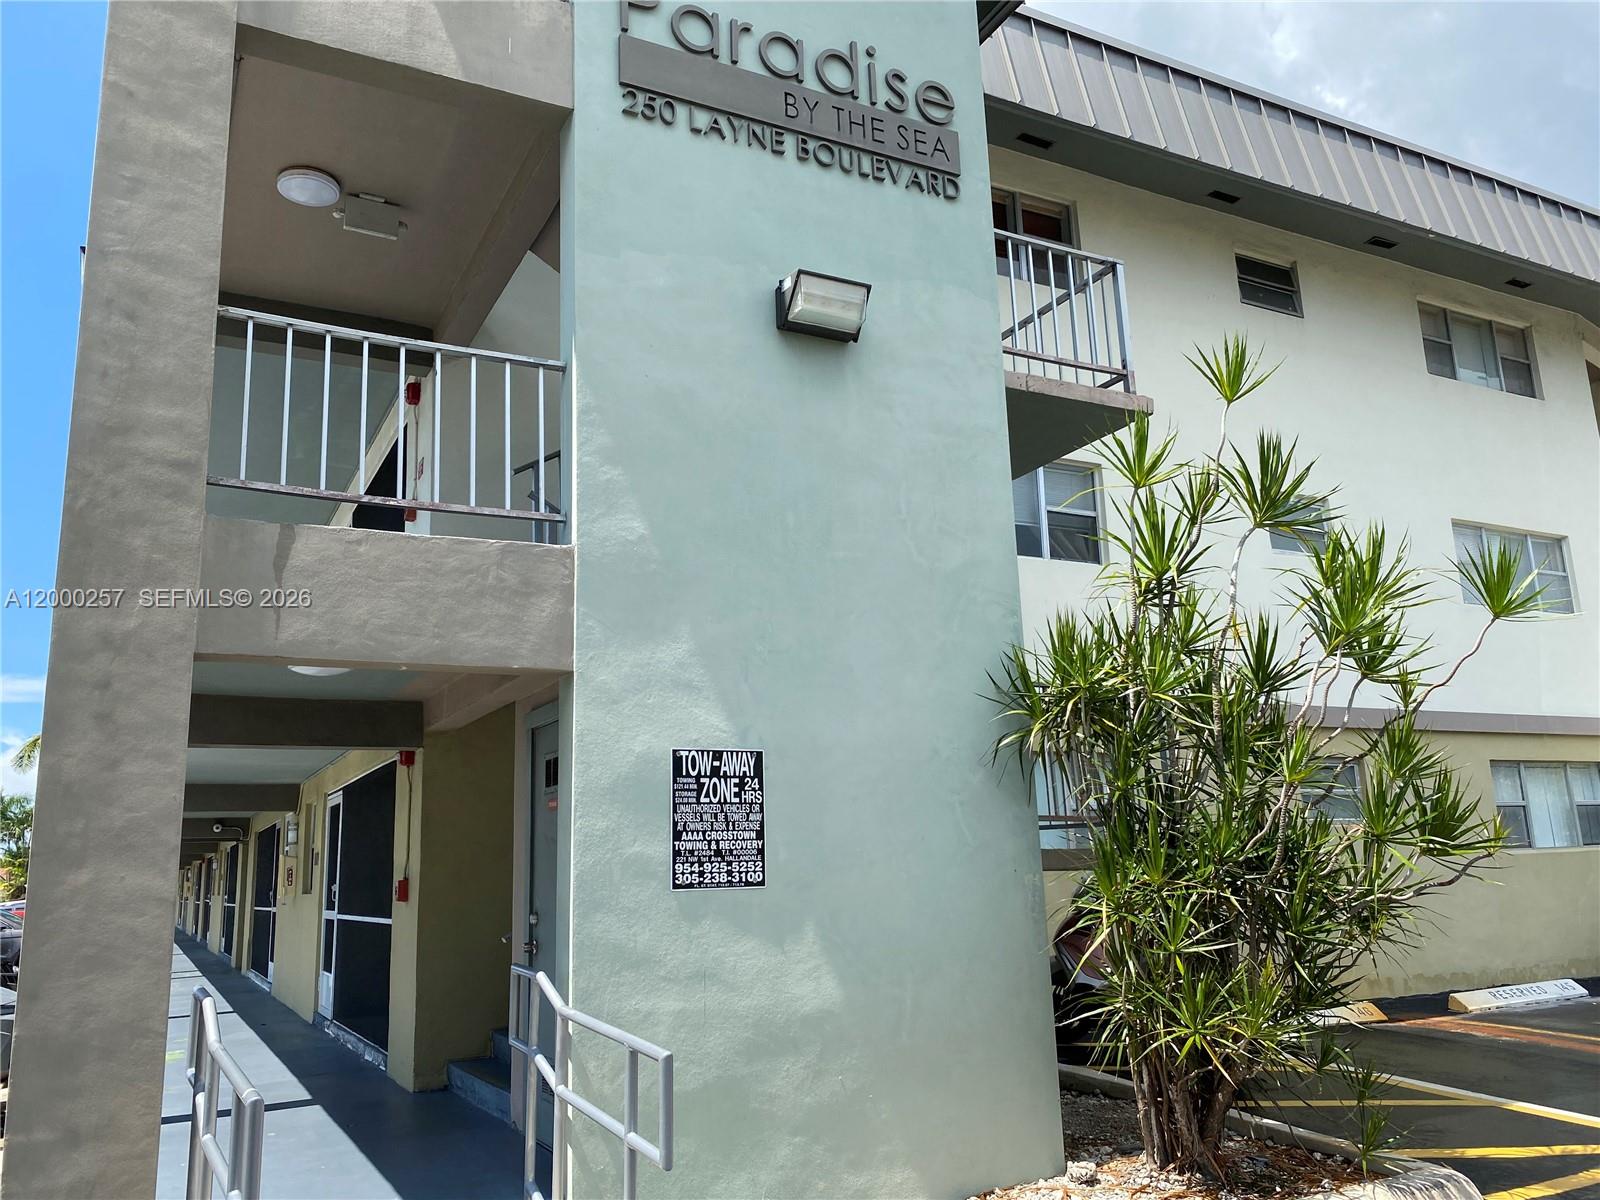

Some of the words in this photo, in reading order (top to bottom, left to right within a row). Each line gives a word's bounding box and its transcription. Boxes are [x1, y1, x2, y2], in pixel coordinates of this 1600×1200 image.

[784, 92, 820, 125] BY
[831, 105, 886, 145] THE
[896, 124, 951, 163] SEA
[622, 88, 678, 126] 250
[690, 107, 786, 156] LAYNE
[797, 136, 961, 201] BOULEVARD
[680, 751, 757, 776] TOW-AWAY
[744, 778, 759, 790] 24
[700, 778, 740, 803] ZONE
[741, 791, 762, 803] HRS
[677, 804, 721, 813] UNAUTHORIZED
[722, 804, 750, 813] VEHICLES
[751, 804, 761, 813] OR
[674, 813, 701, 822] VESSELS
[702, 813, 716, 821] WILL
[717, 813, 726, 821] BE
[727, 813, 747, 821] TOWED
[748, 813, 763, 821] AWAY
[676, 822, 685, 831] AT
[686, 822, 712, 831] OWNERS
[713, 822, 727, 830] RISK
[728, 822, 734, 830] &
[735, 821, 761, 830] EXPENSE
[681, 831, 704, 841] AAAA
[705, 831, 756, 840] CROSSTOWN
[674, 841, 709, 851] TOWING
[710, 840, 717, 850] &
[719, 840, 763, 850] RECOVERY
[675, 861, 763, 873] 954-925-5252
[675, 871, 763, 884] 305-238-3100
[1488, 985, 1548, 1001] RESERVED
[1554, 981, 1576, 993] 145
